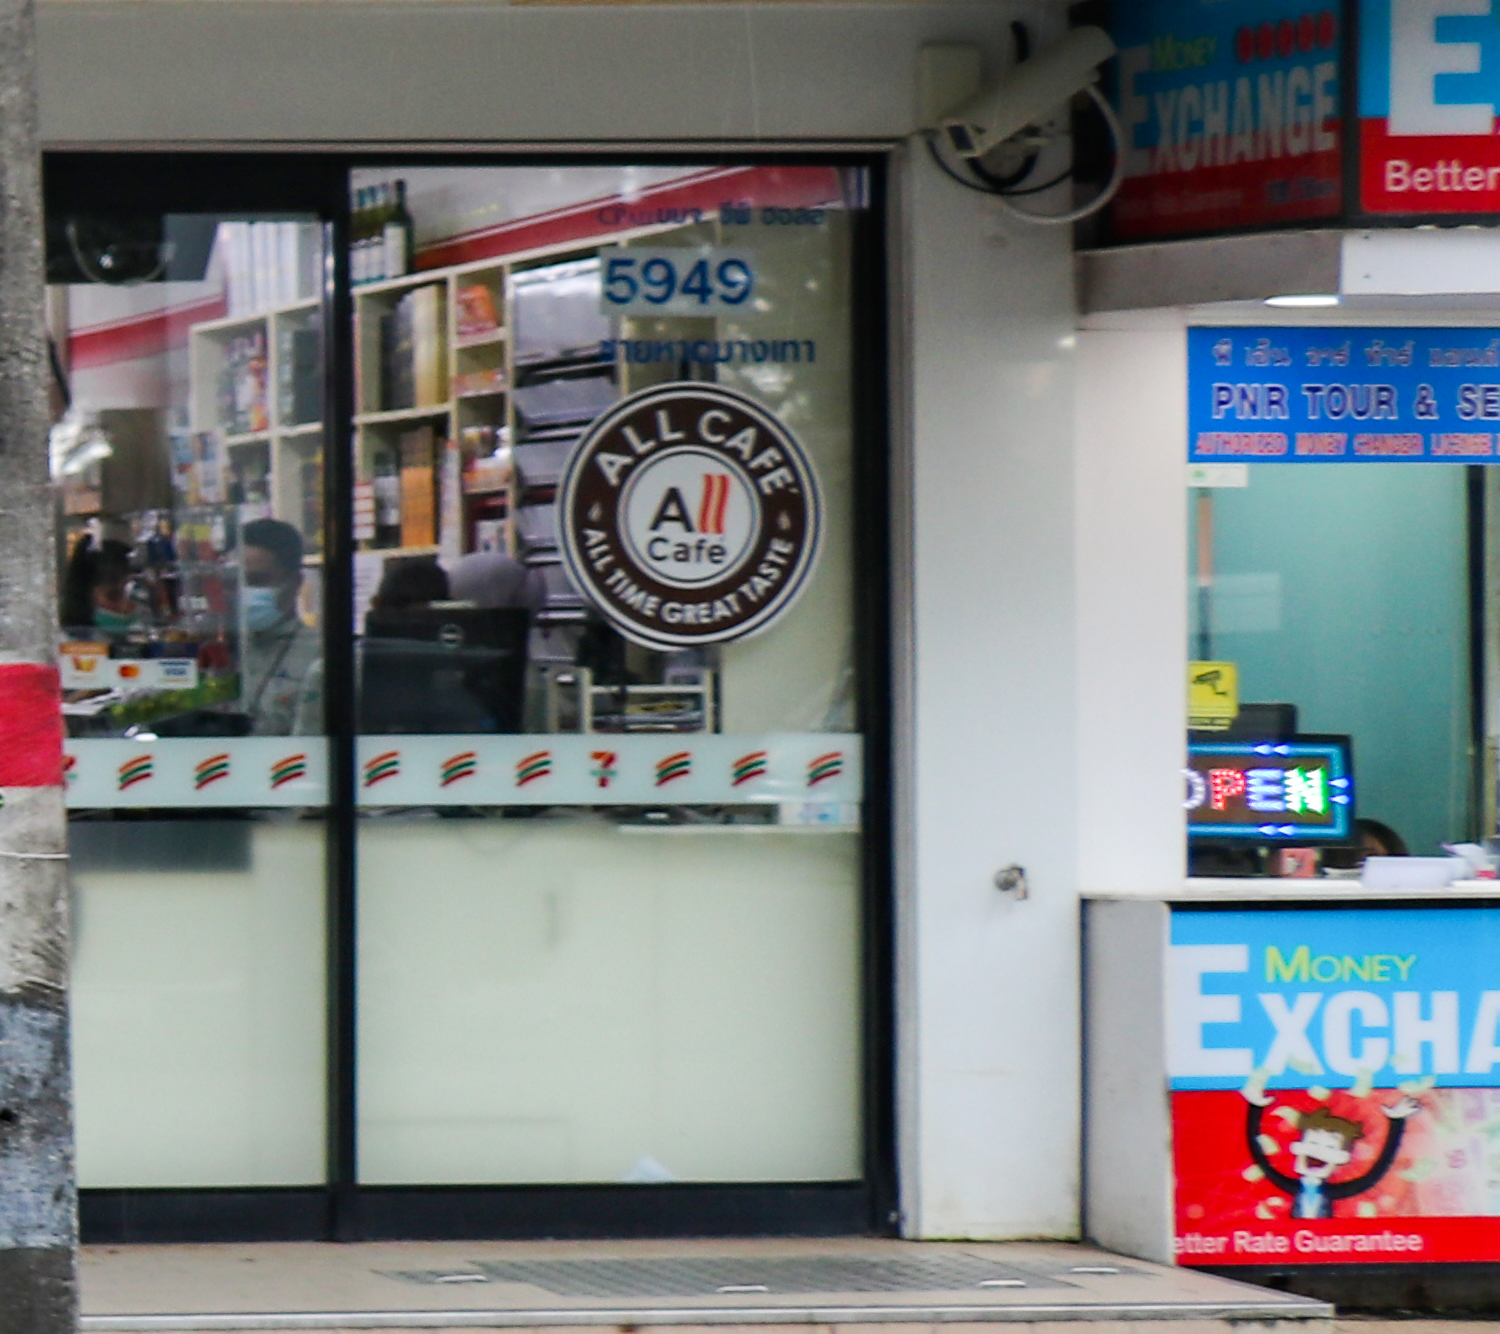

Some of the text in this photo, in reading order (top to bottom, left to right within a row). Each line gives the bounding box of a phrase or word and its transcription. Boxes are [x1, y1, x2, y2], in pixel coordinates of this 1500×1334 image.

[1118, 45, 1338, 180] EXCHANGE
[605, 258, 752, 305] 5949
[1211, 383, 1290, 420] PNR
[1301, 383, 1399, 420] TOUR
[594, 409, 685, 488] ALL
[582, 527, 795, 625] ALL TIME GREAT TASTE
[1265, 945, 1417, 983] MONEY
[1172, 1228, 1423, 1256] etter Rate Guarantee
